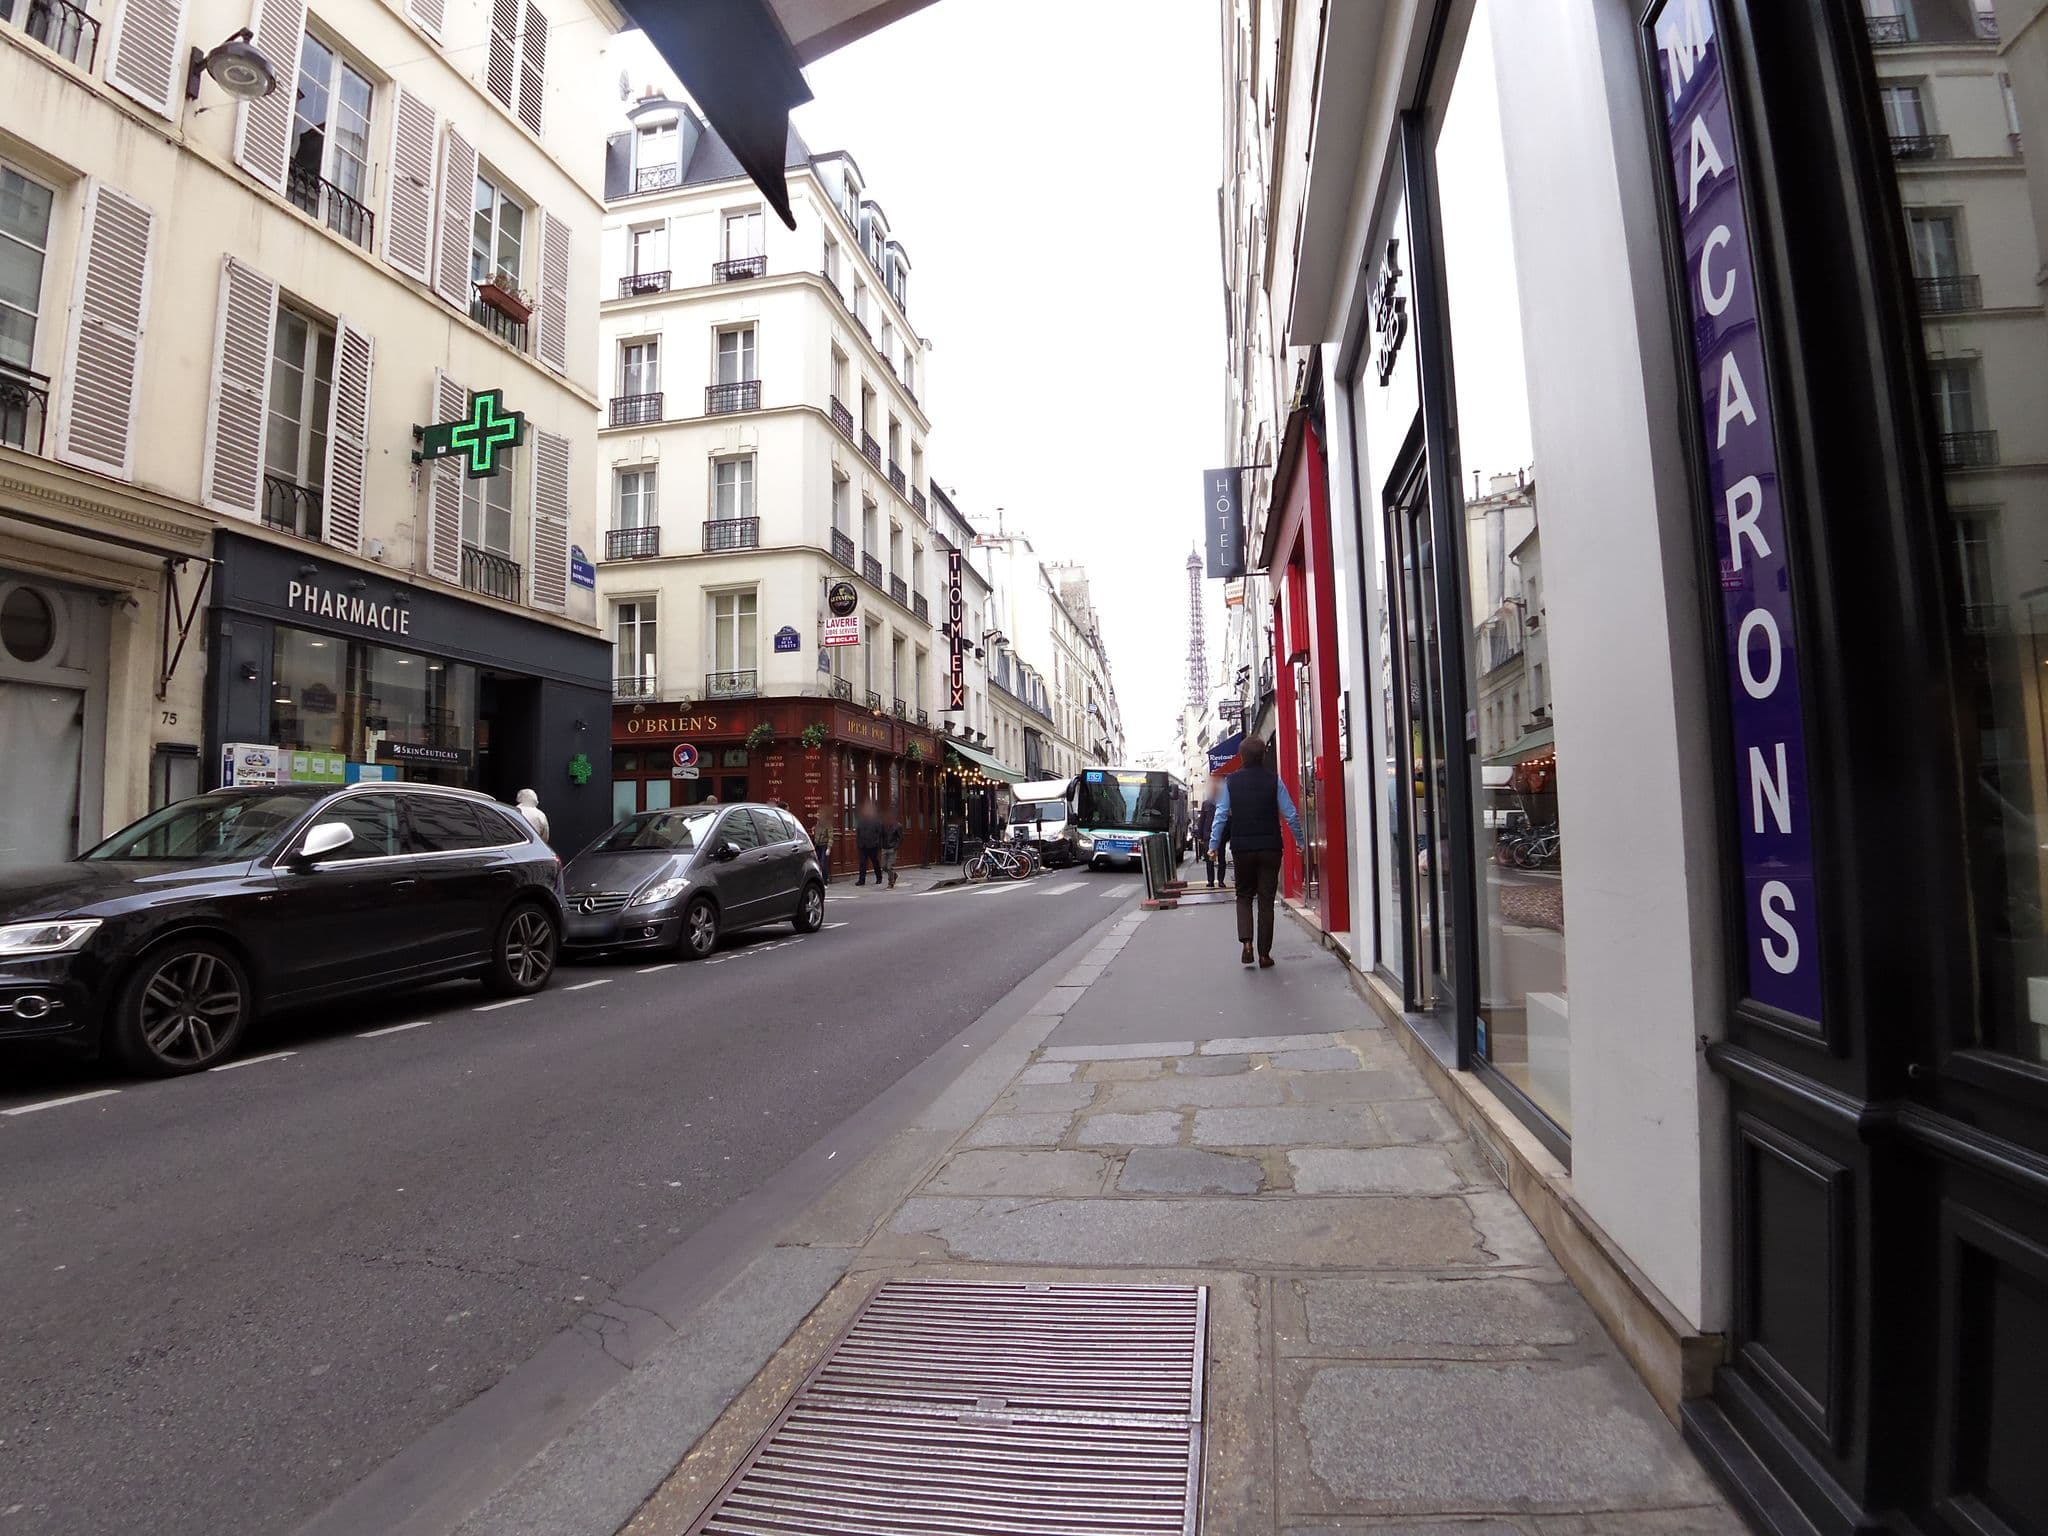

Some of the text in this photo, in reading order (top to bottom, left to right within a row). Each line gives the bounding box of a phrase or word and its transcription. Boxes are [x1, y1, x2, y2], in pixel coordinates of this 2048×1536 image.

[1668, 0, 1800, 975] MACARONS
[1216, 479, 1230, 566] HÔTEL
[288, 580, 410, 635] PHARMACIE
[826, 617, 858, 628] LAVERIE
[950, 553, 963, 706] THOUMIEUX
[162, 711, 177, 725] 75
[627, 716, 717, 733] O'BRIEN'S
